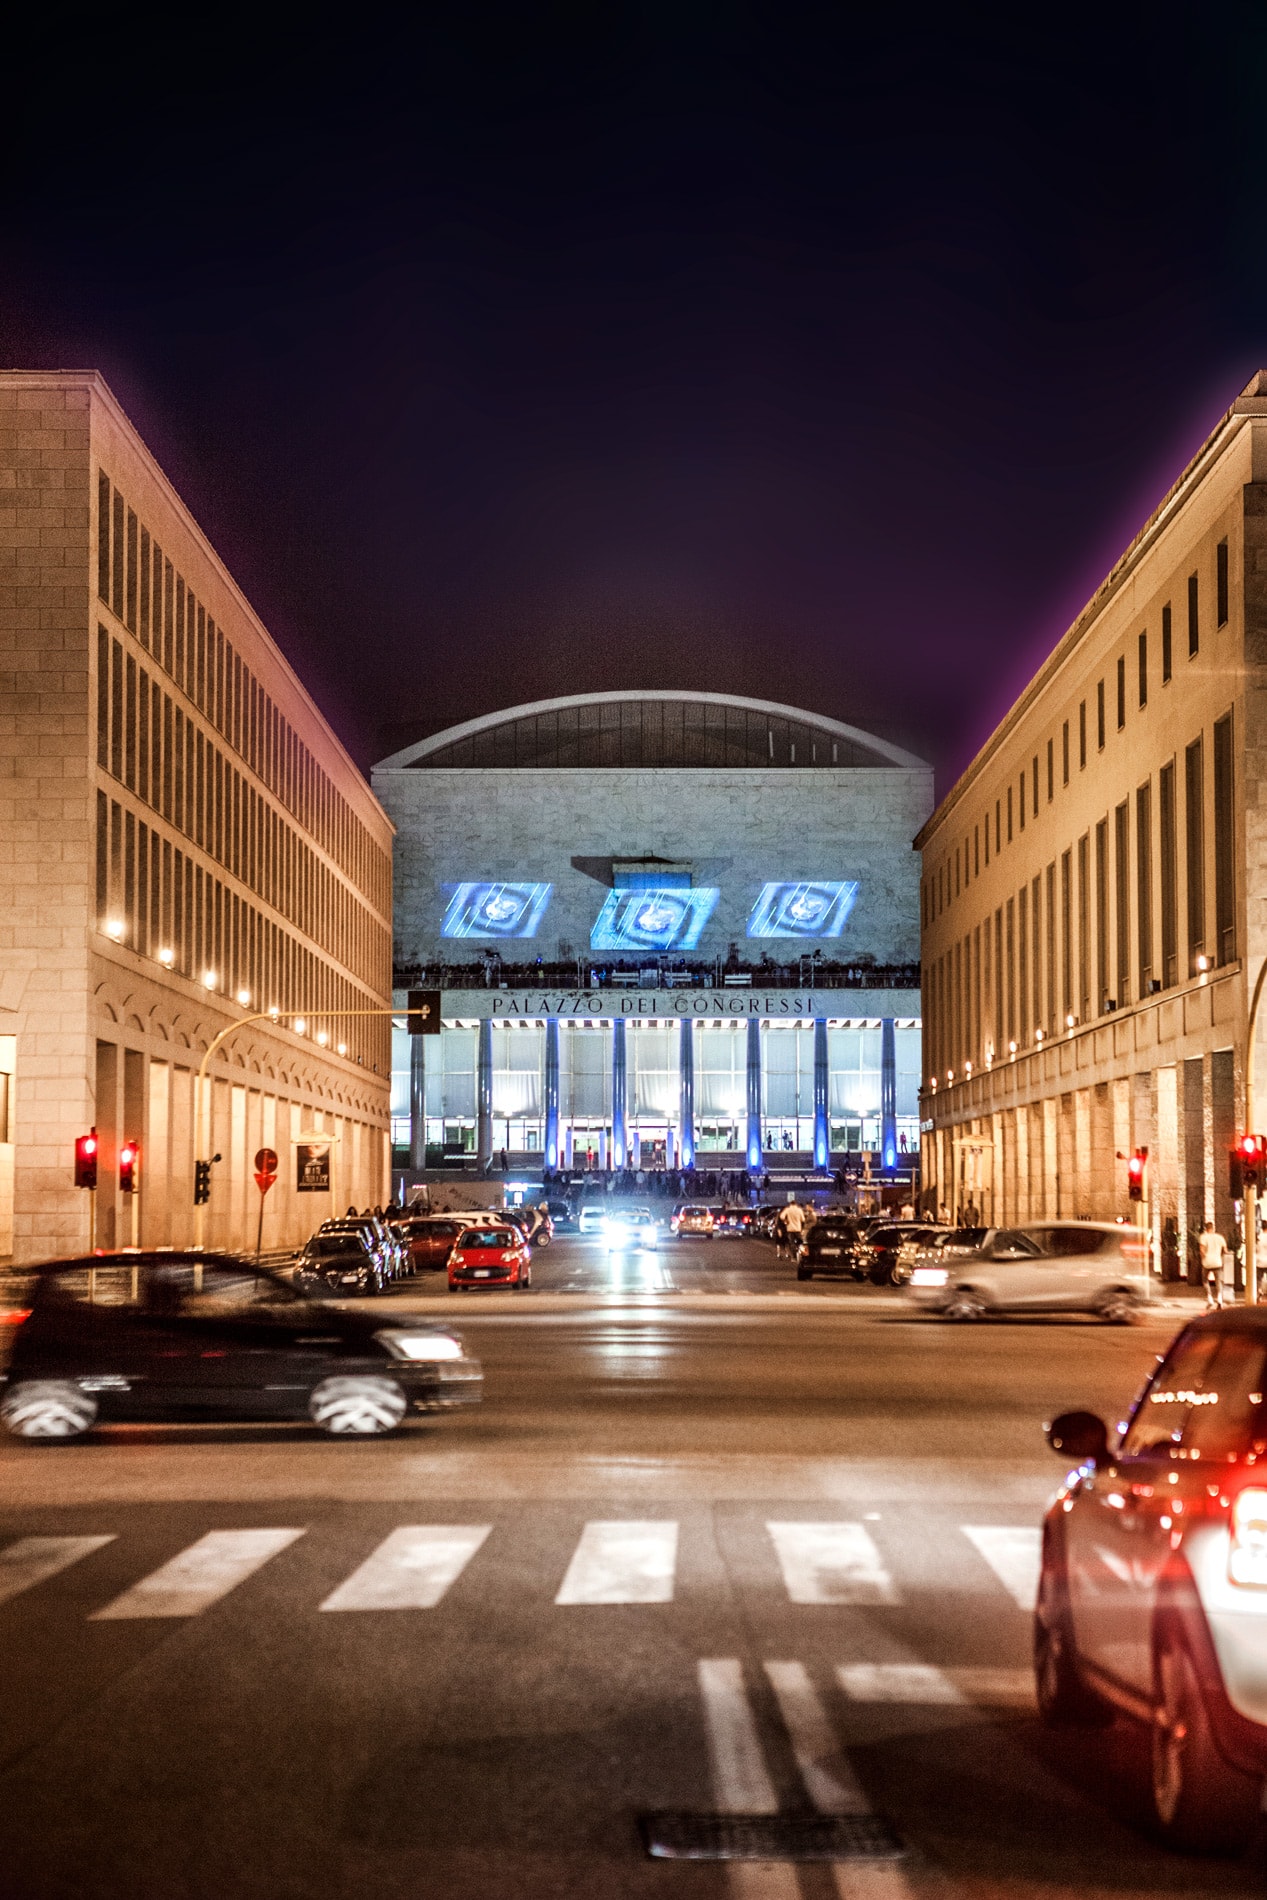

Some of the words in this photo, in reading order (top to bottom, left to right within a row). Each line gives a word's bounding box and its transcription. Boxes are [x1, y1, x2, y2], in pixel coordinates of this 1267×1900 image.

[492, 998, 604, 1013] PALAZZO
[621, 998, 658, 1013] DEI
[674, 998, 813, 1013] CONGRESSI
